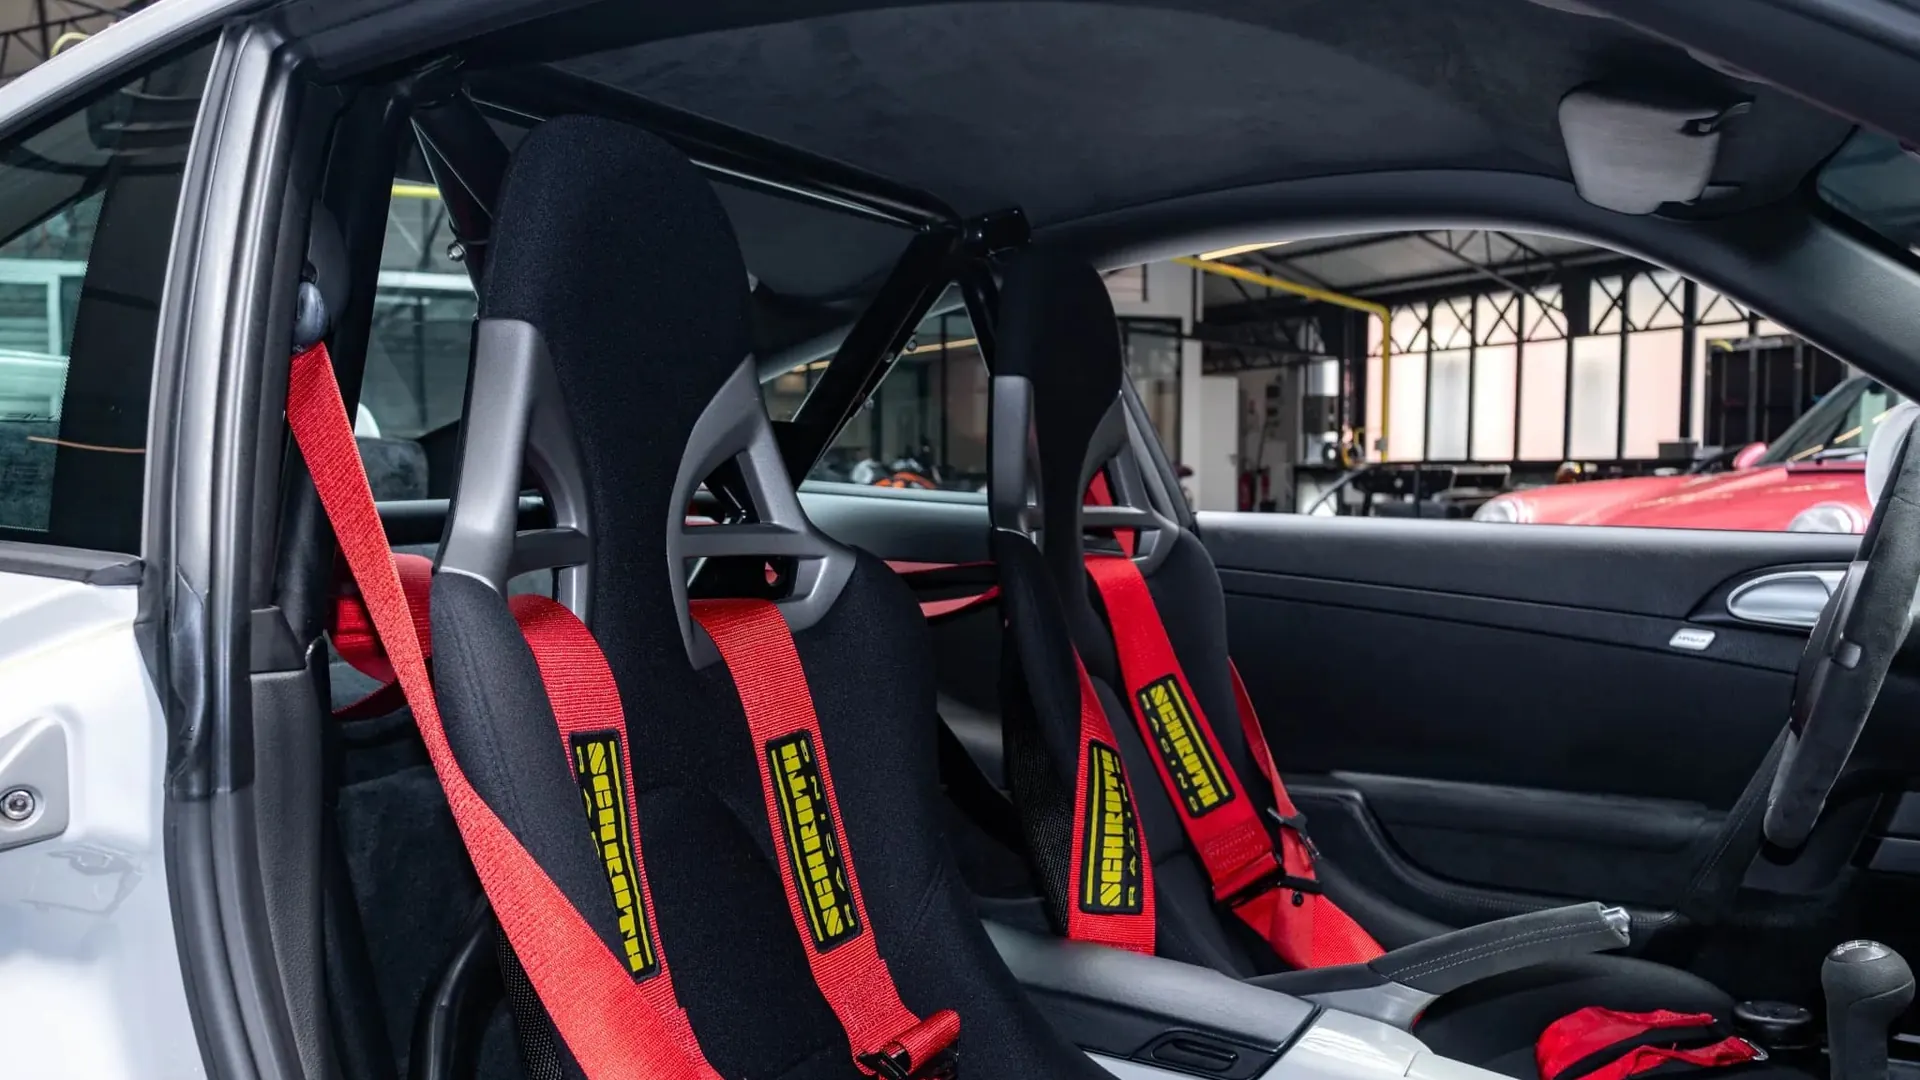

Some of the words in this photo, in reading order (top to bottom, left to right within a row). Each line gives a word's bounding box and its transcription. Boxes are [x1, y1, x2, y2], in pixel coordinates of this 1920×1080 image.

[1141, 693, 1199, 812] RACING
[1150, 684, 1219, 807] SCHROTH
[588, 741, 644, 973] SCHROTH
[781, 743, 844, 937] SCHROTH
[800, 739, 855, 927] RACING
[1100, 749, 1124, 907] SCHROTH
[1114, 756, 1136, 907] RACING
